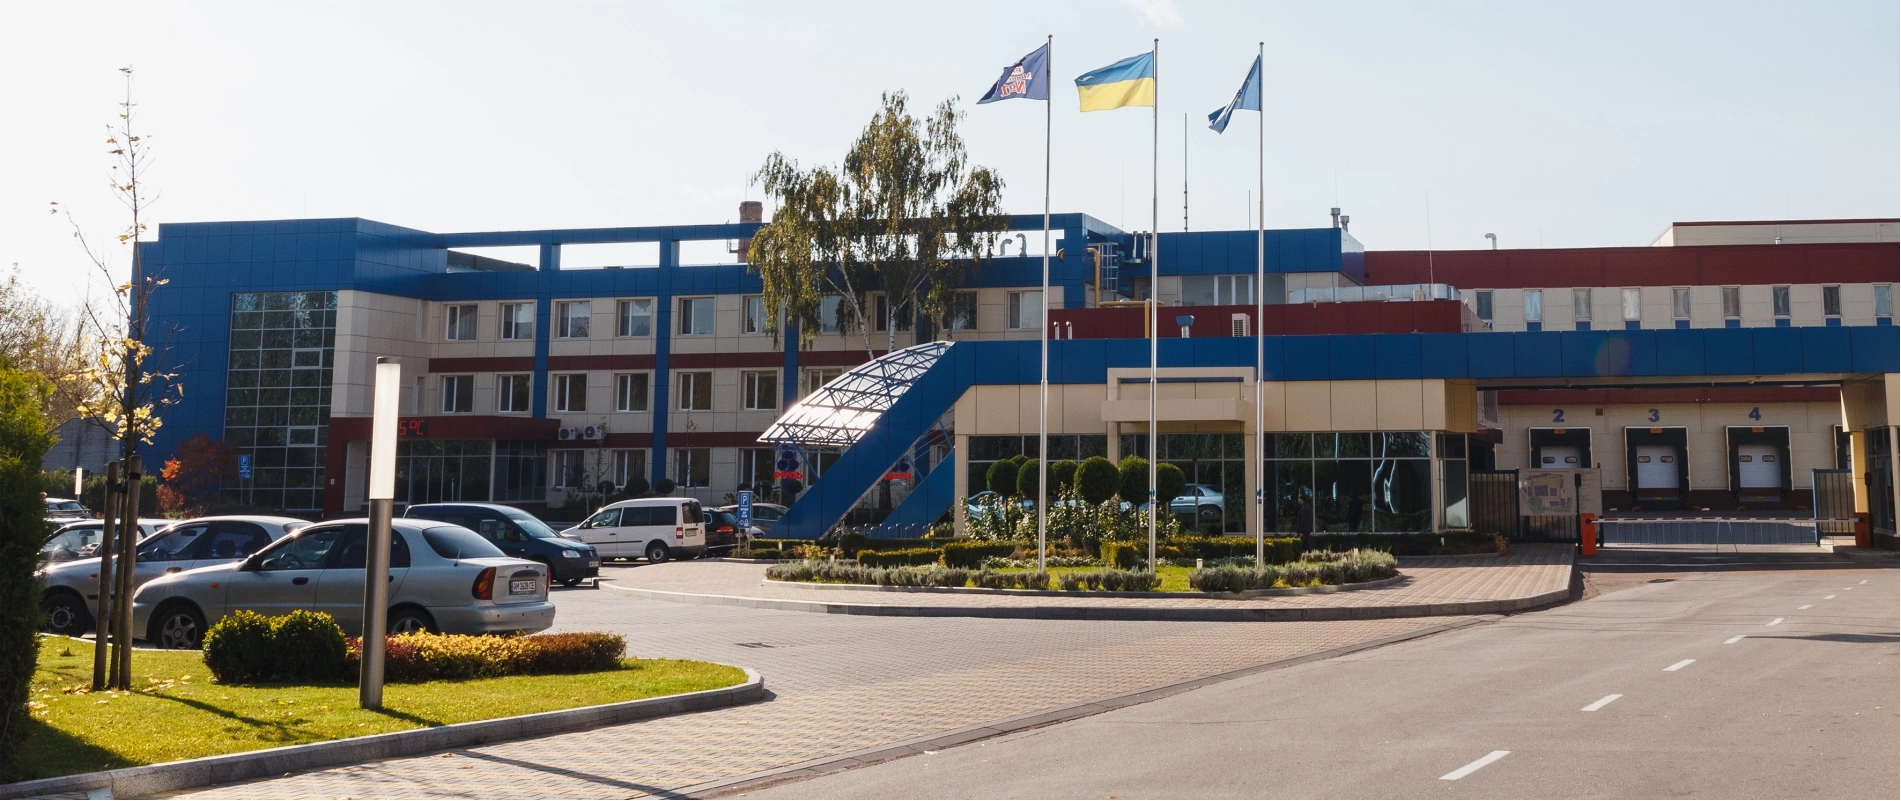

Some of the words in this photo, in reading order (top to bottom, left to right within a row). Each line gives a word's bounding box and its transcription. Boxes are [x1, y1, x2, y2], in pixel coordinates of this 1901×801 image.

[1553, 409, 1564, 422] 2
[1648, 409, 1660, 422] 3
[1748, 407, 1761, 420] 4
